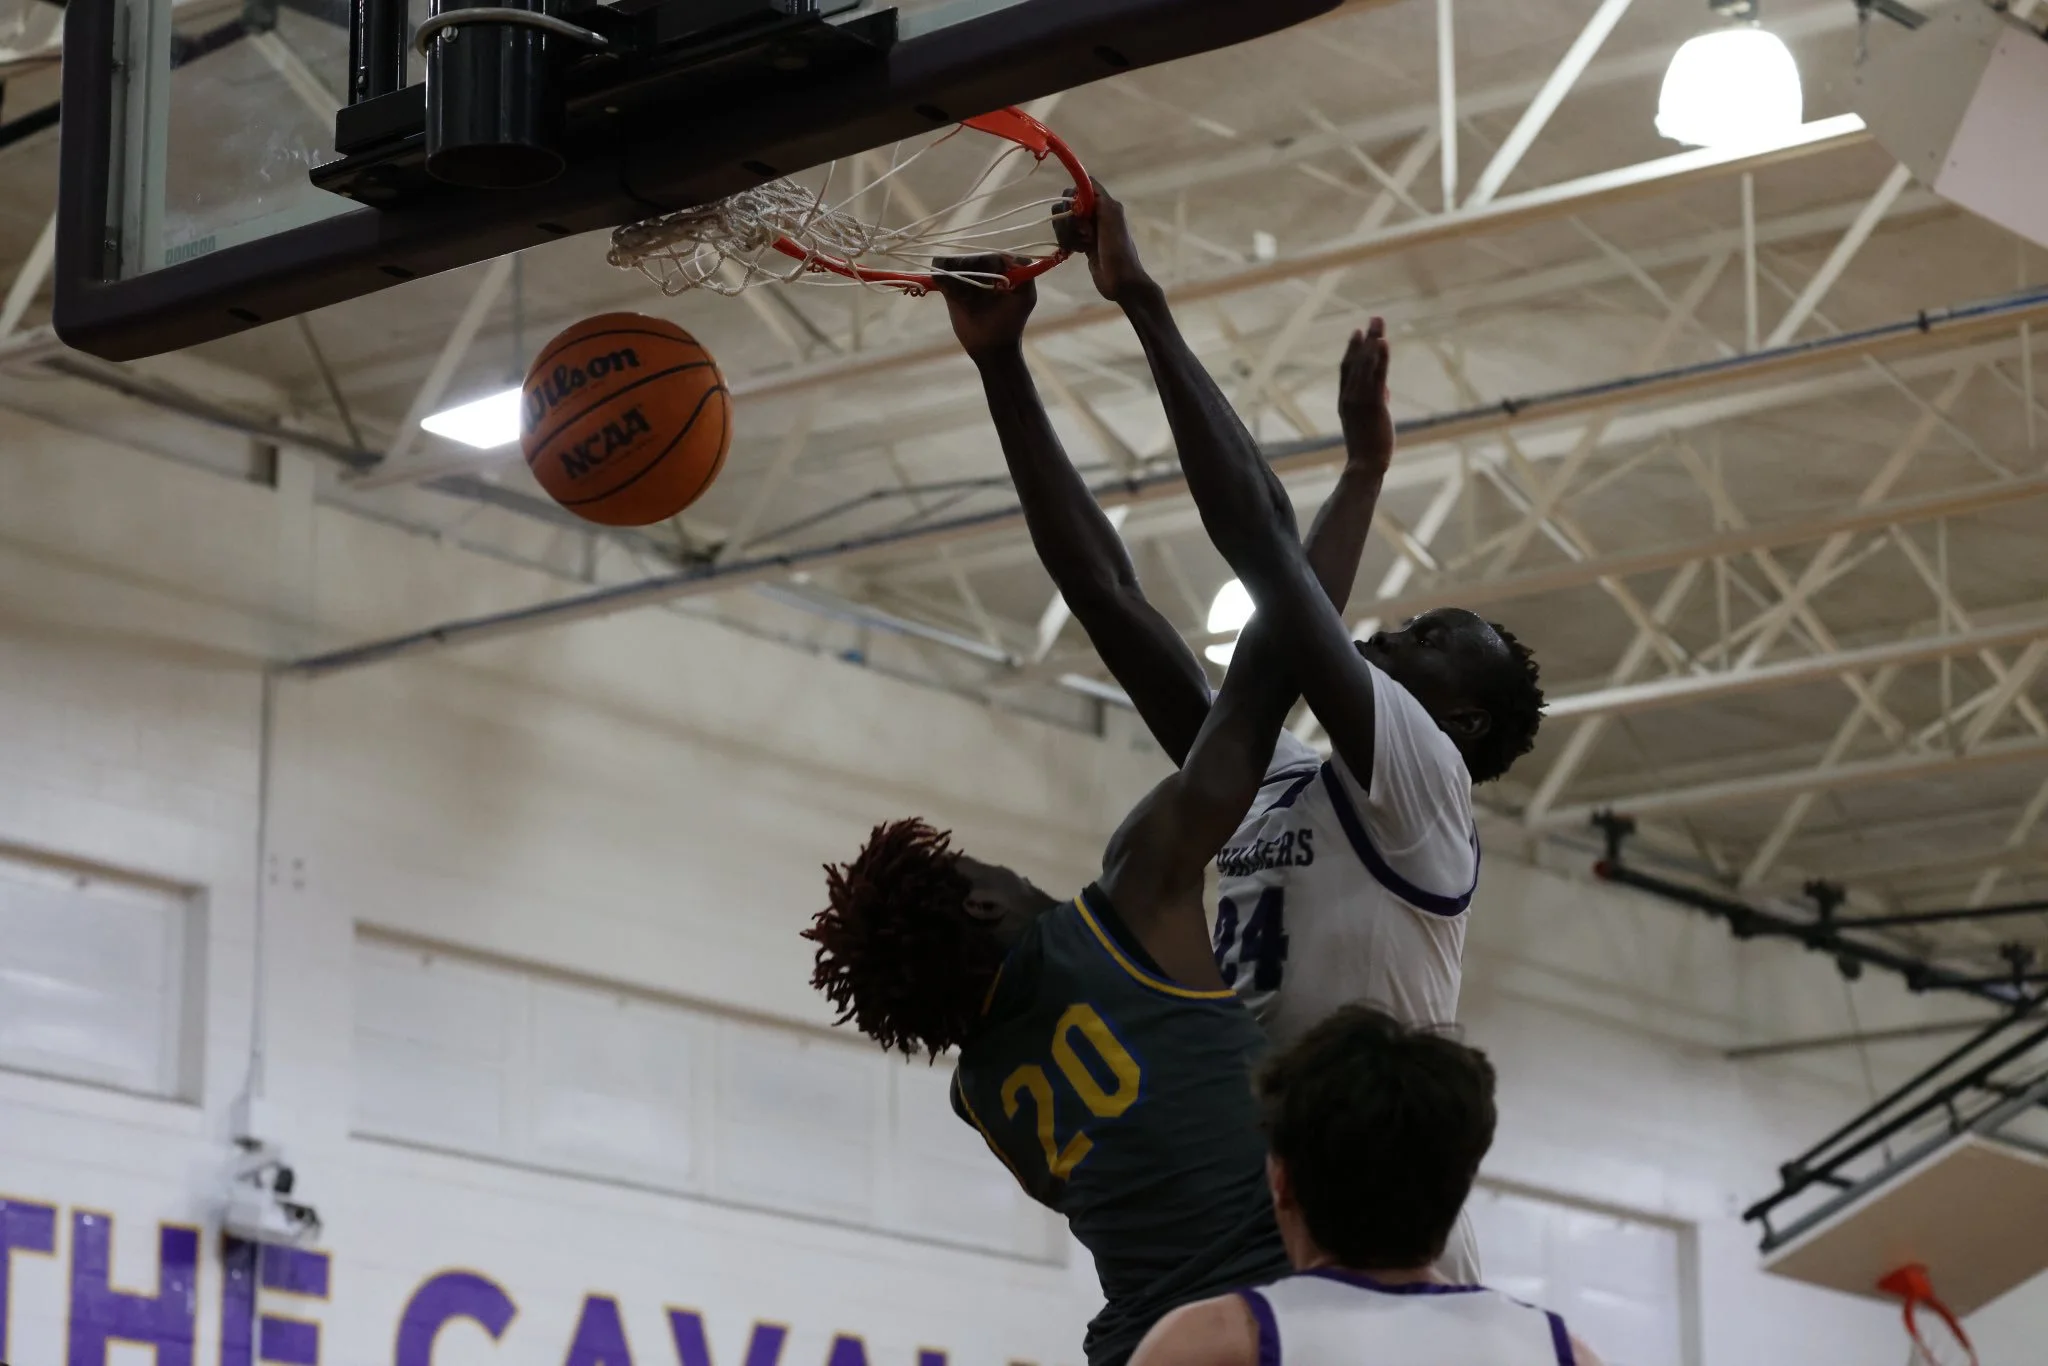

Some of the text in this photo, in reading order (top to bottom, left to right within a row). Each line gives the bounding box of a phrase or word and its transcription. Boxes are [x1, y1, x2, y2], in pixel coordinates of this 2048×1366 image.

[557, 406, 651, 480] NCAA
[1213, 886, 1289, 992] 24
[1000, 1001, 1142, 1181] 20
